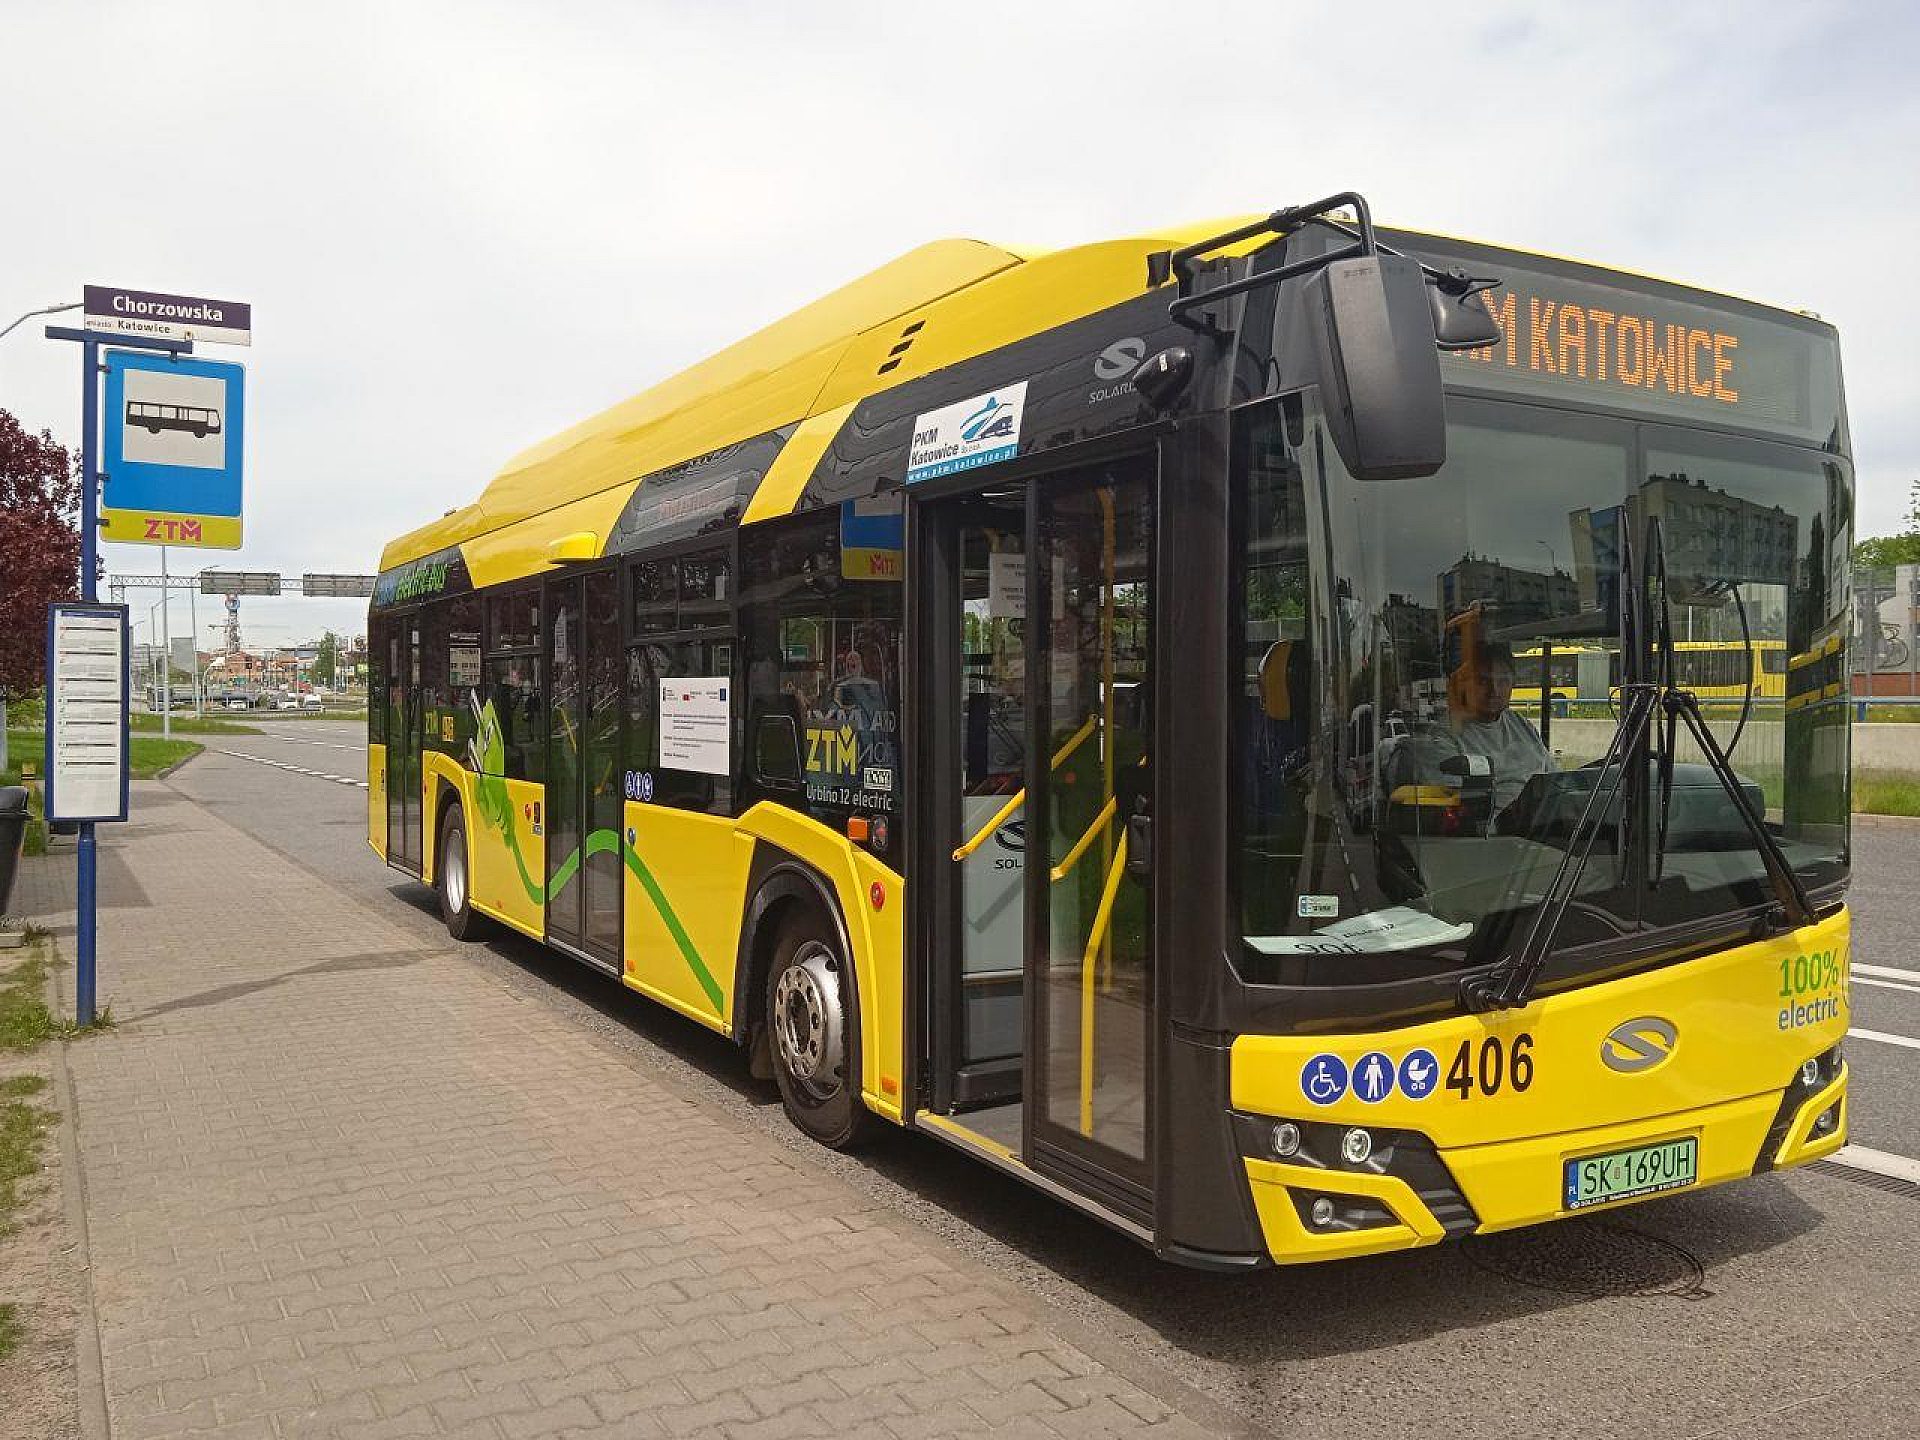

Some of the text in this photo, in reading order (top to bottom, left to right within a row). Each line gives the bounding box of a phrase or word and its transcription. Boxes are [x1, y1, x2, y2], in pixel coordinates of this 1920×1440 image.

[113, 296, 223, 322] Chorzowska
[118, 320, 171, 334] Katowice
[1530, 296, 1738, 402] KATOWICE
[1089, 382, 1137, 404] SOLARI
[914, 426, 938, 447] PKM
[911, 443, 959, 466] Katowice
[144, 518, 201, 542] ZTM
[805, 724, 856, 776] ZTM
[806, 783, 893, 811] Urbino 12 electric
[994, 859, 1023, 869] SOL
[1778, 947, 1839, 997] 100%
[1778, 991, 1838, 1030] electric
[1446, 1033, 1534, 1100] 406
[1584, 1159, 1613, 1194] SK
[1623, 1144, 1690, 1187] 169UH
[1568, 1185, 1578, 1196] PL
